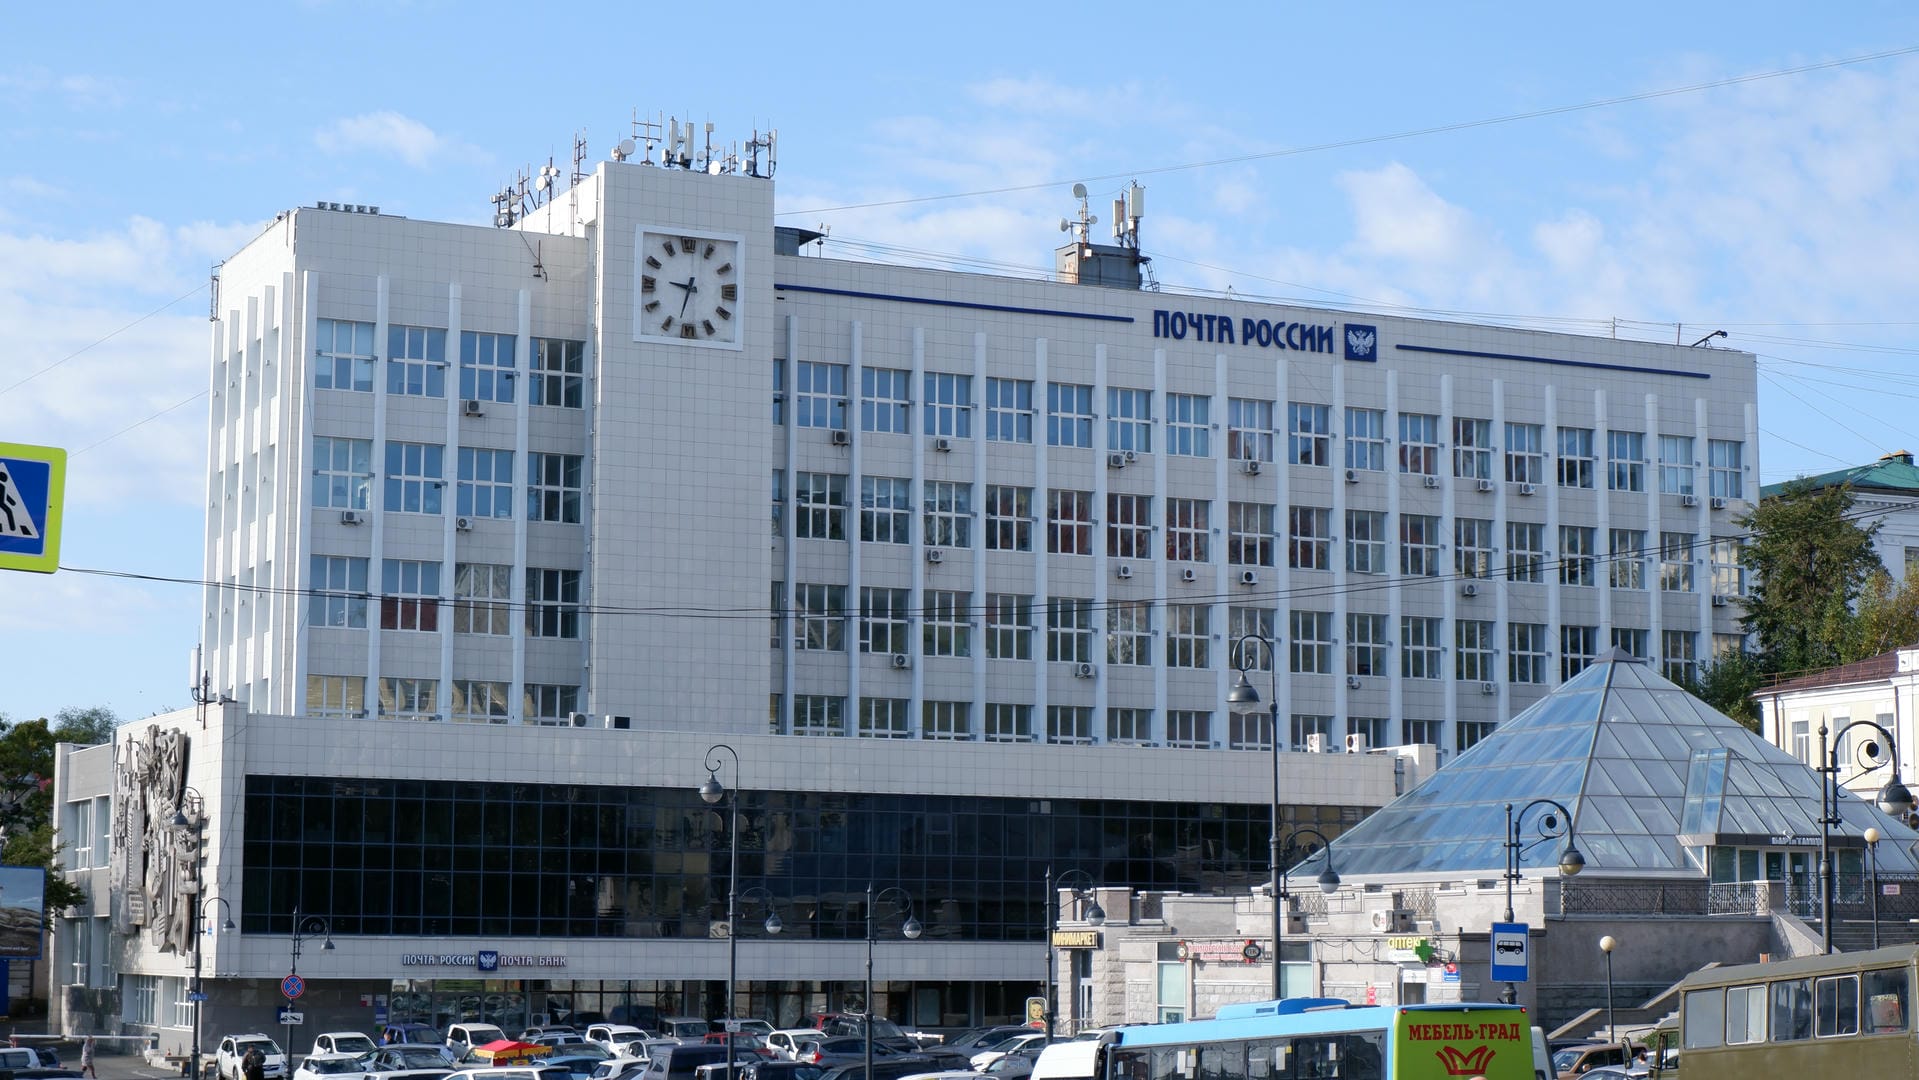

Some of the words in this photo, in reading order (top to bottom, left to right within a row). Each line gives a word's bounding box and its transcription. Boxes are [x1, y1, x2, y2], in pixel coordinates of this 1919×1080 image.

[1153, 309, 1235, 344] ПОЧТА
[1242, 317, 1334, 354] РОССИИ
[403, 954, 435, 966] ПОЧТА
[440, 954, 476, 966] РОССИИ
[500, 955, 533, 967] ПОЧТА
[539, 955, 567, 967] БАНК
